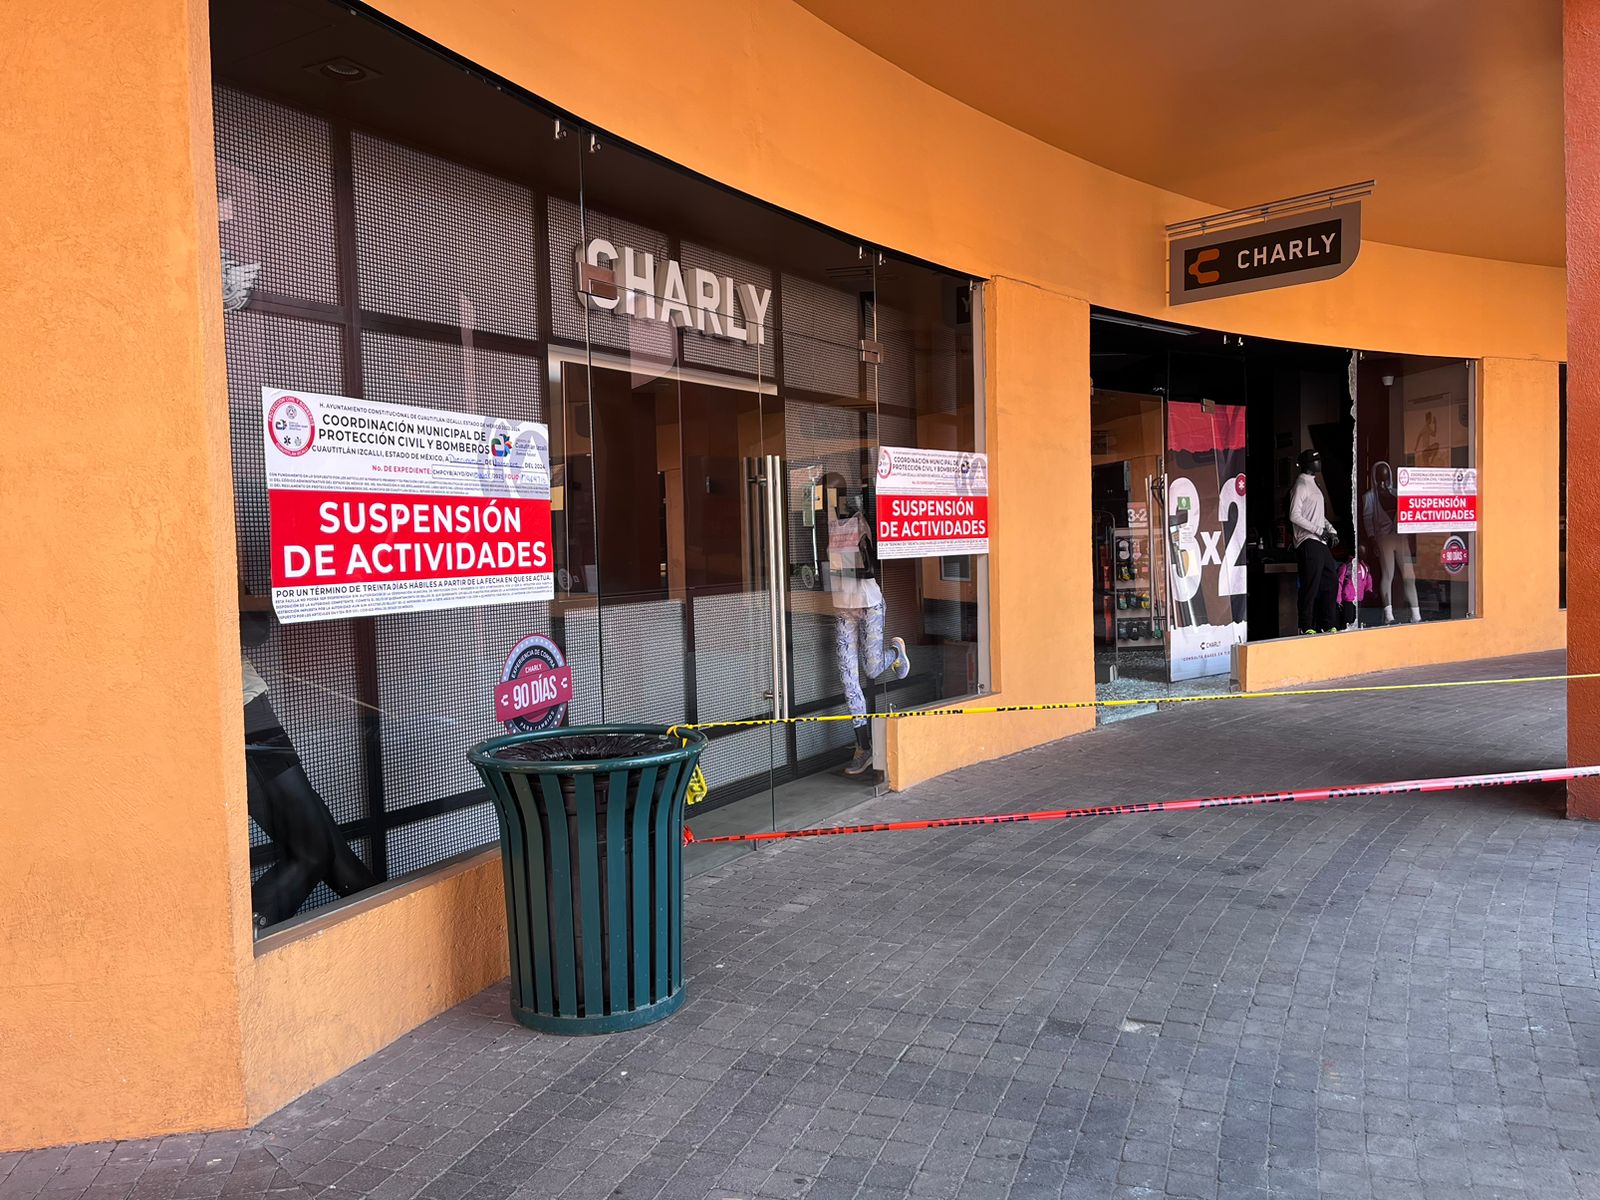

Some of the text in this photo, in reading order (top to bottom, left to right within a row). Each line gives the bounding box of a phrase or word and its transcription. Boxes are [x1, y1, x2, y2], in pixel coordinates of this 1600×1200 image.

[1237, 232, 1336, 269] CHARLY
[577, 238, 772, 345] CHARLY
[326, 404, 368, 414] AYUNTAMIENTO
[368, 408, 410, 418] CONSTITUCIONAL
[322, 414, 414, 434] COORDINACIÓN
[417, 424, 472, 440] MUNICIPAL
[474, 431, 486, 441] DE
[318, 428, 490, 454] PROTECCIÓN CIVIL Y BOMBEROS
[311, 445, 356, 455] CUAUTITLÁN
[357, 448, 384, 458] IZCALLI,
[385, 450, 410, 459] ESTADO
[420, 453, 445, 462] MÉXICO,
[393, 466, 432, 475] EXPEDIENTE:
[891, 497, 974, 517] SUSPENSIÓN
[1408, 496, 1466, 508] SUSPENSIÓN
[318, 499, 521, 534] SUSPENSIÓN
[1400, 510, 1474, 521] DE ACTIVIDADES
[880, 520, 986, 538] DE ACTIVIDADES
[283, 540, 548, 578] DE ACTIVIDADES
[276, 590, 294, 598] POR
[310, 586, 347, 596] TÉRMINO
[362, 583, 391, 592] TREINTA
[392, 582, 408, 590] DÍAS
[409, 580, 437, 589] HÁBILES
[444, 579, 466, 587] PARTIR
[511, 650, 534, 678] EXPERIENCIA
[540, 650, 555, 668] COMPRA
[524, 663, 543, 674] CHARLY
[513, 674, 557, 710] 90 DÍAS
[520, 711, 555, 731] PARA CAMBIOS
